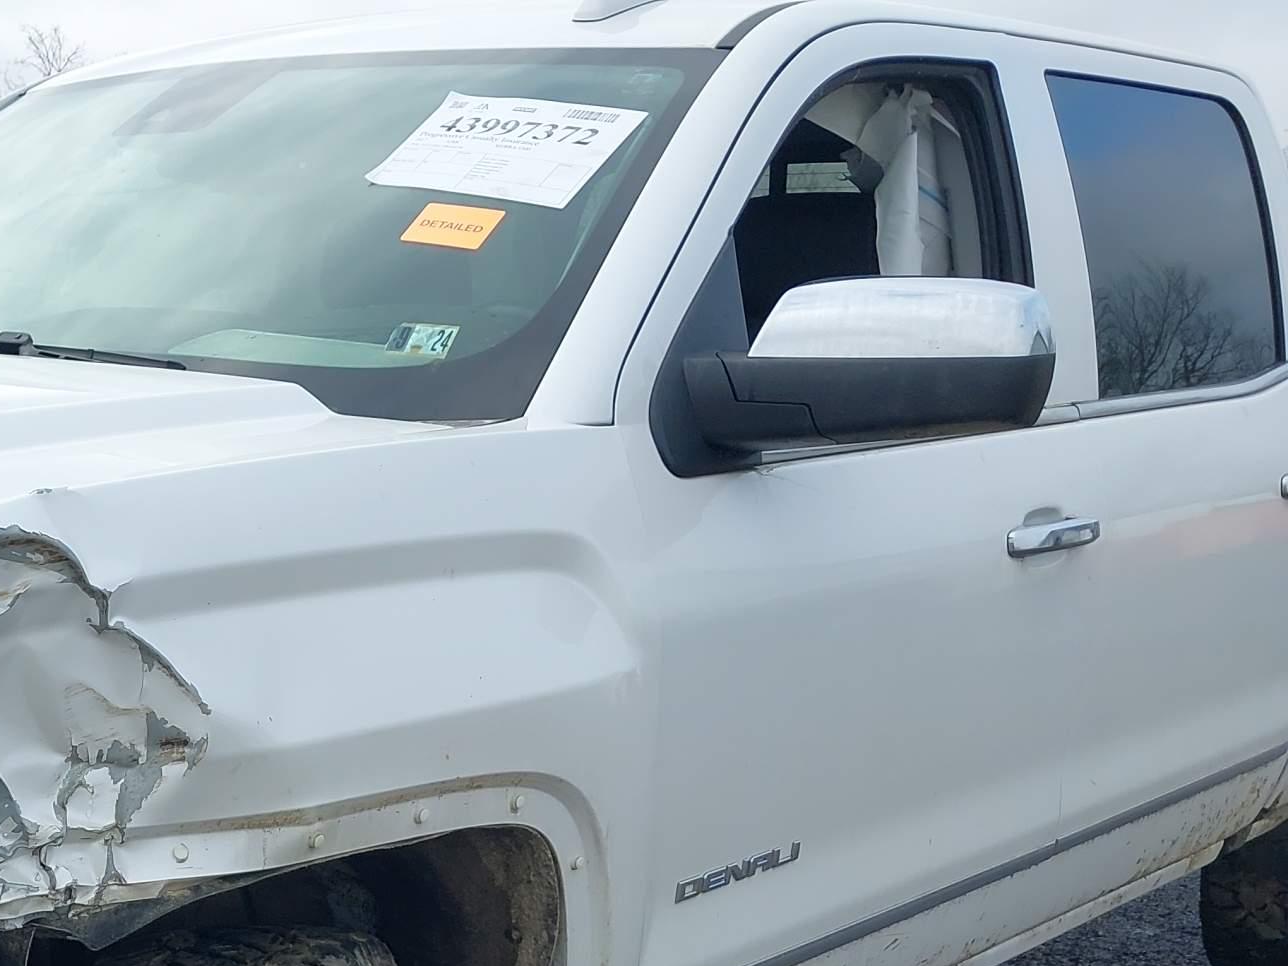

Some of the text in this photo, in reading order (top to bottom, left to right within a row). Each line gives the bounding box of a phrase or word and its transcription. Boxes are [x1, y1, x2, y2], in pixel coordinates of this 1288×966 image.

[439, 115, 600, 146] 43997372
[419, 218, 484, 233] DETAILED
[430, 329, 454, 353] 24
[674, 839, 801, 905] DENALI
